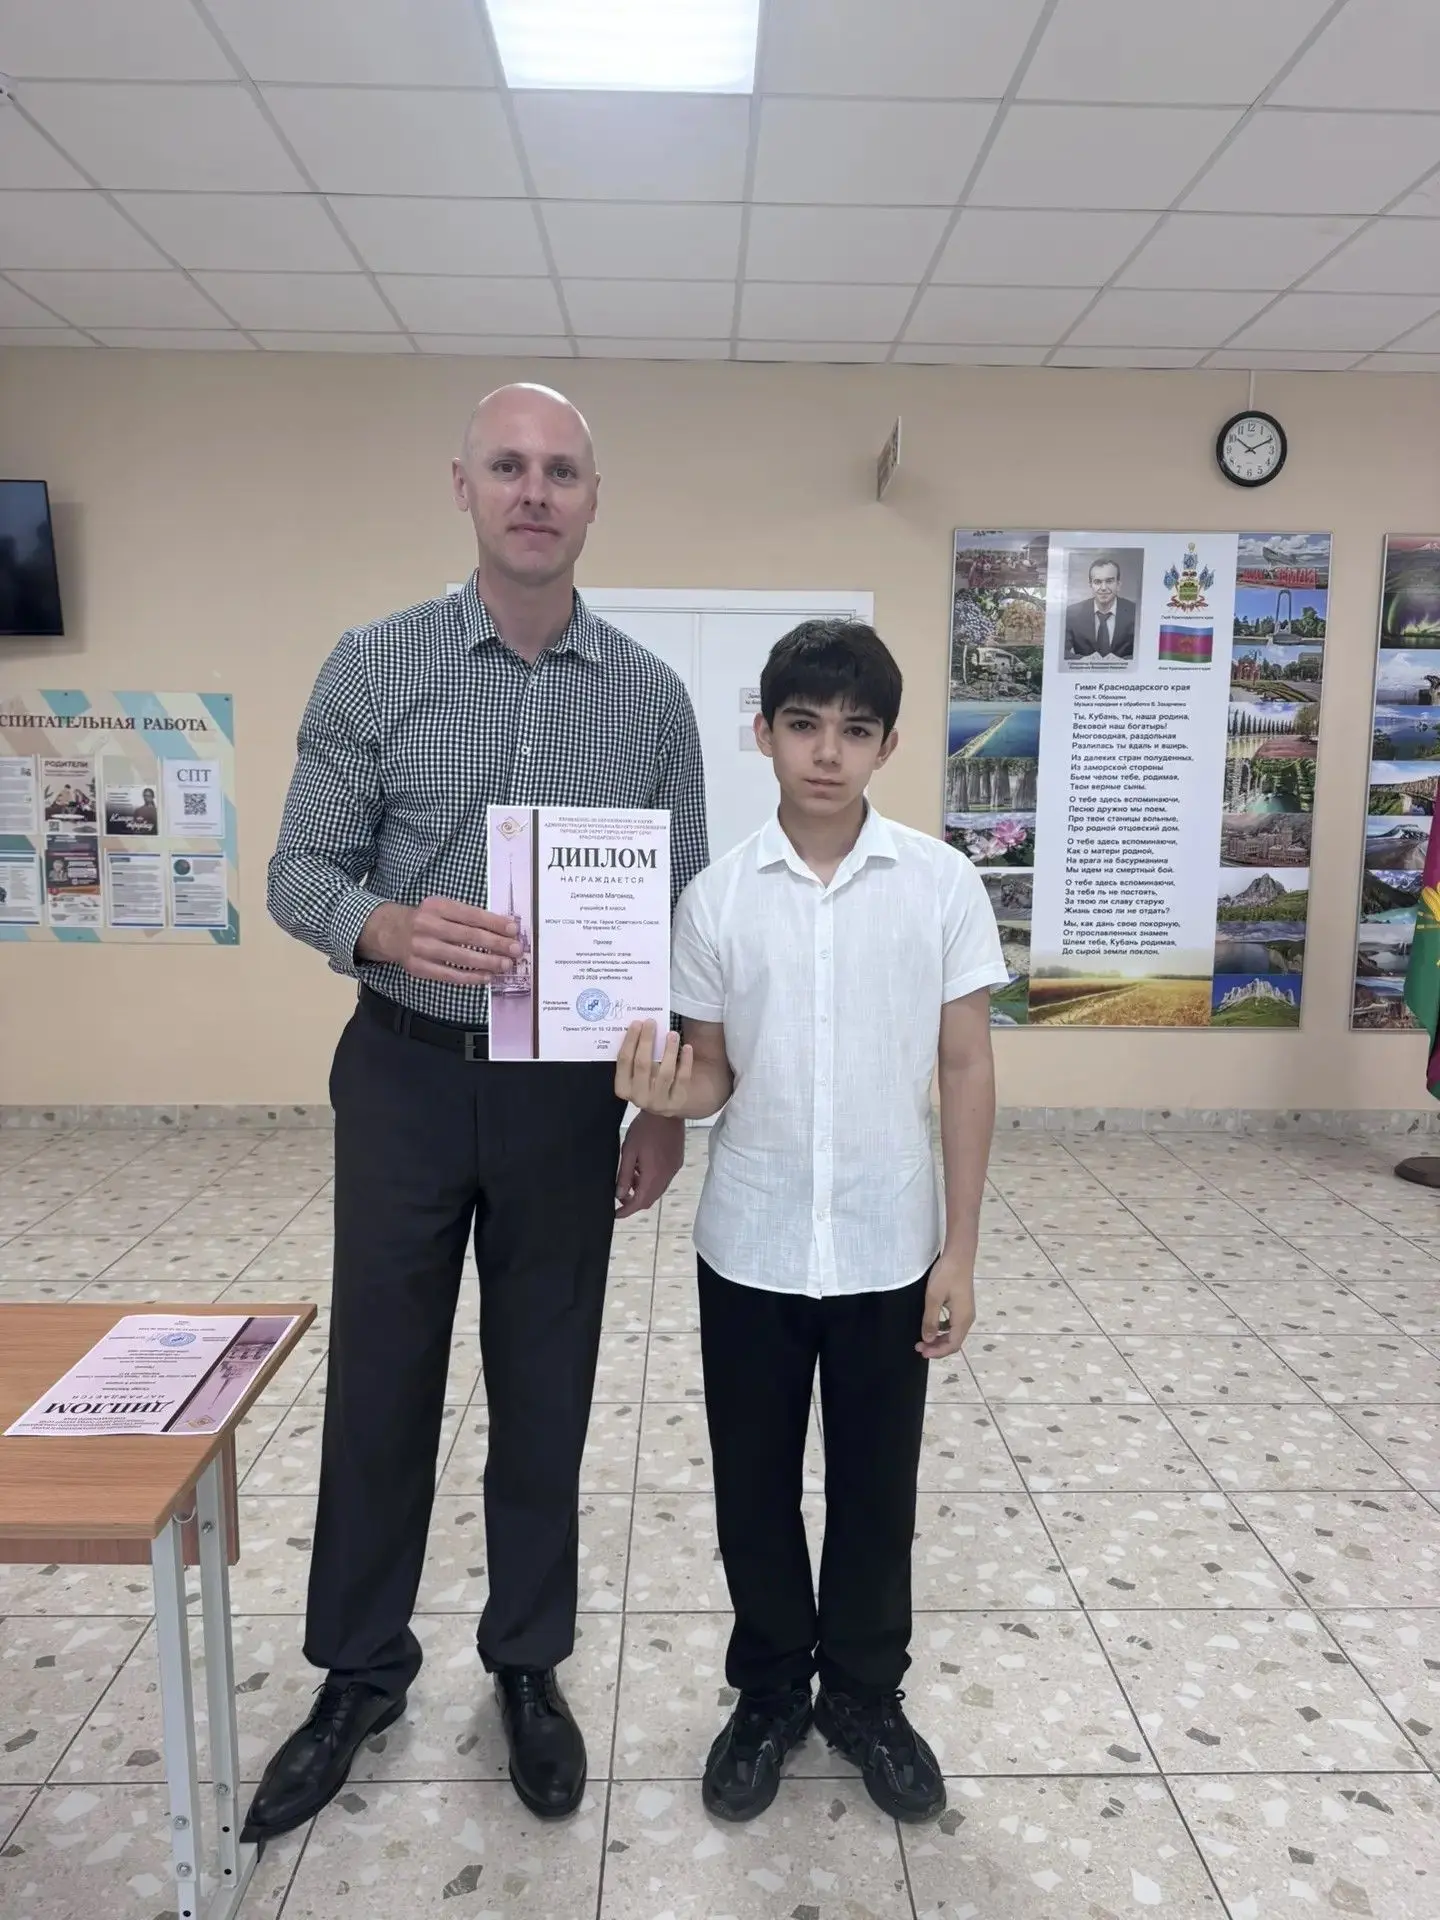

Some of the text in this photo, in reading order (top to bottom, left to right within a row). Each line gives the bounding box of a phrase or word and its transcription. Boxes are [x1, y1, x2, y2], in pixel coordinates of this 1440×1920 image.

[1098, 684, 1169, 693] Краснодарского
[1171, 685, 1190, 693] края
[144, 717, 207, 731] РАБОТА
[44, 760, 88, 768] РОДИТЕЛИ
[176, 768, 211, 782] СПТ
[548, 847, 657, 870] ДИПЛОМ
[1139, 907, 1170, 915] отдать?
[43, 1400, 174, 1414] ДИПЛОМ
